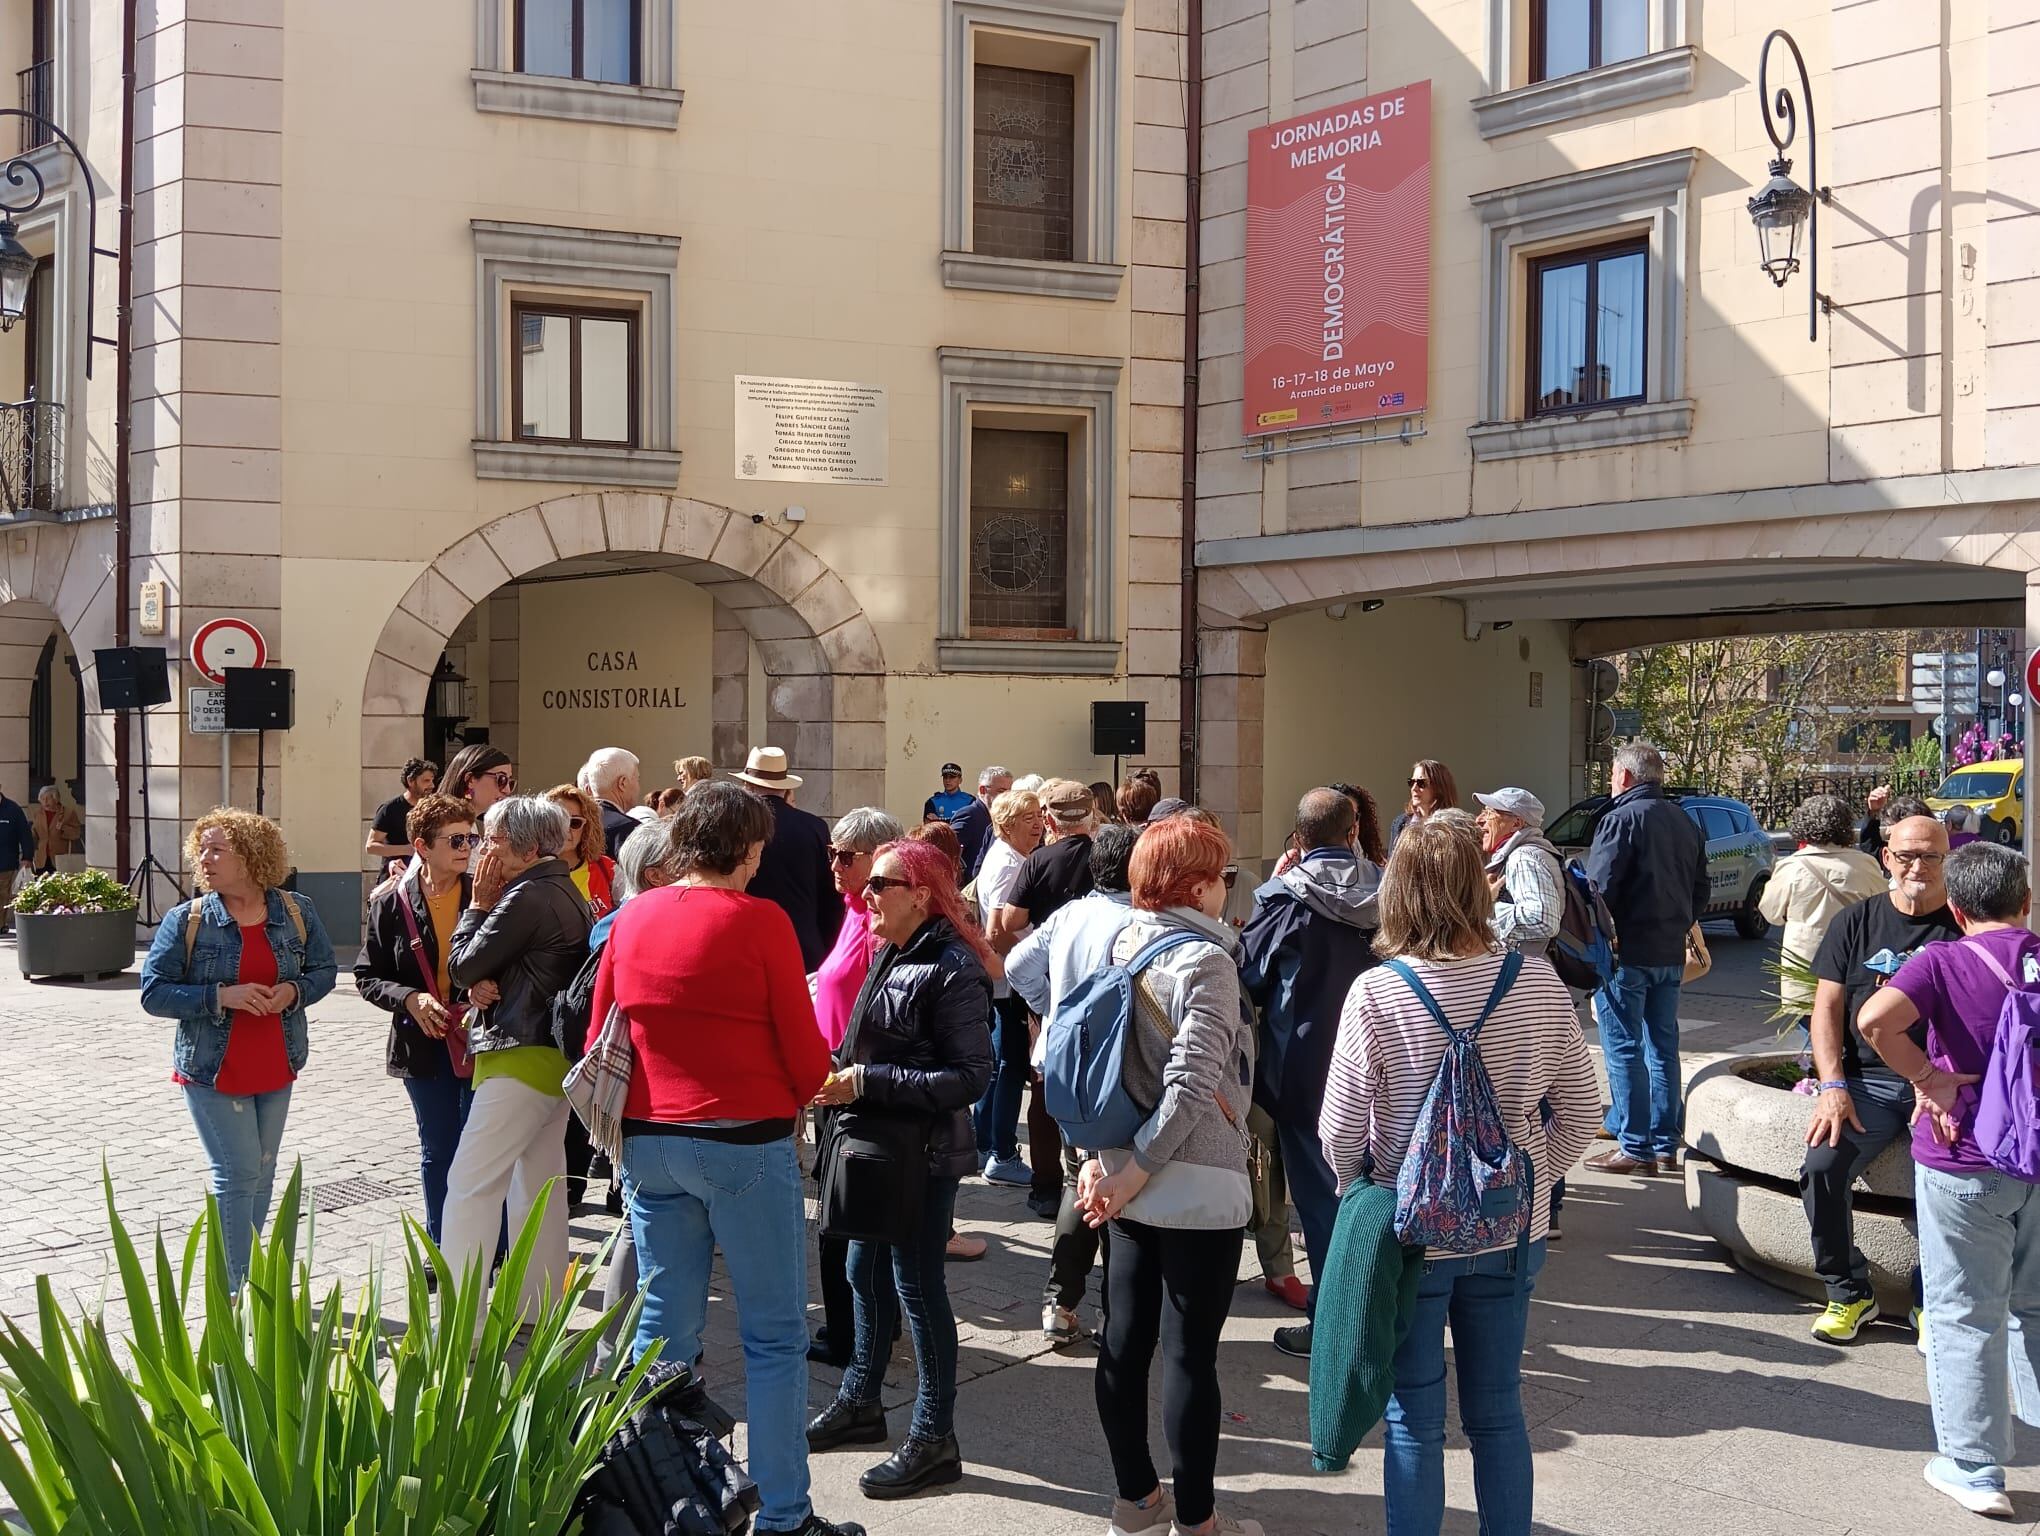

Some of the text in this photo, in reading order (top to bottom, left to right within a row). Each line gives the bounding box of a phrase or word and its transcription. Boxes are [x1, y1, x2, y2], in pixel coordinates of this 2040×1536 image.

[1270, 97, 1406, 150] JORNADAS DE
[1290, 129, 1383, 169] MEMORIA
[1319, 162, 1347, 361] DEMOCRÁTICA
[1271, 359, 1396, 390] 16-17-18 de Mayo
[1289, 379, 1376, 400] Aranda de Duero
[587, 650, 638, 671] CASA
[542, 687, 687, 710] CONSISTORIAL
